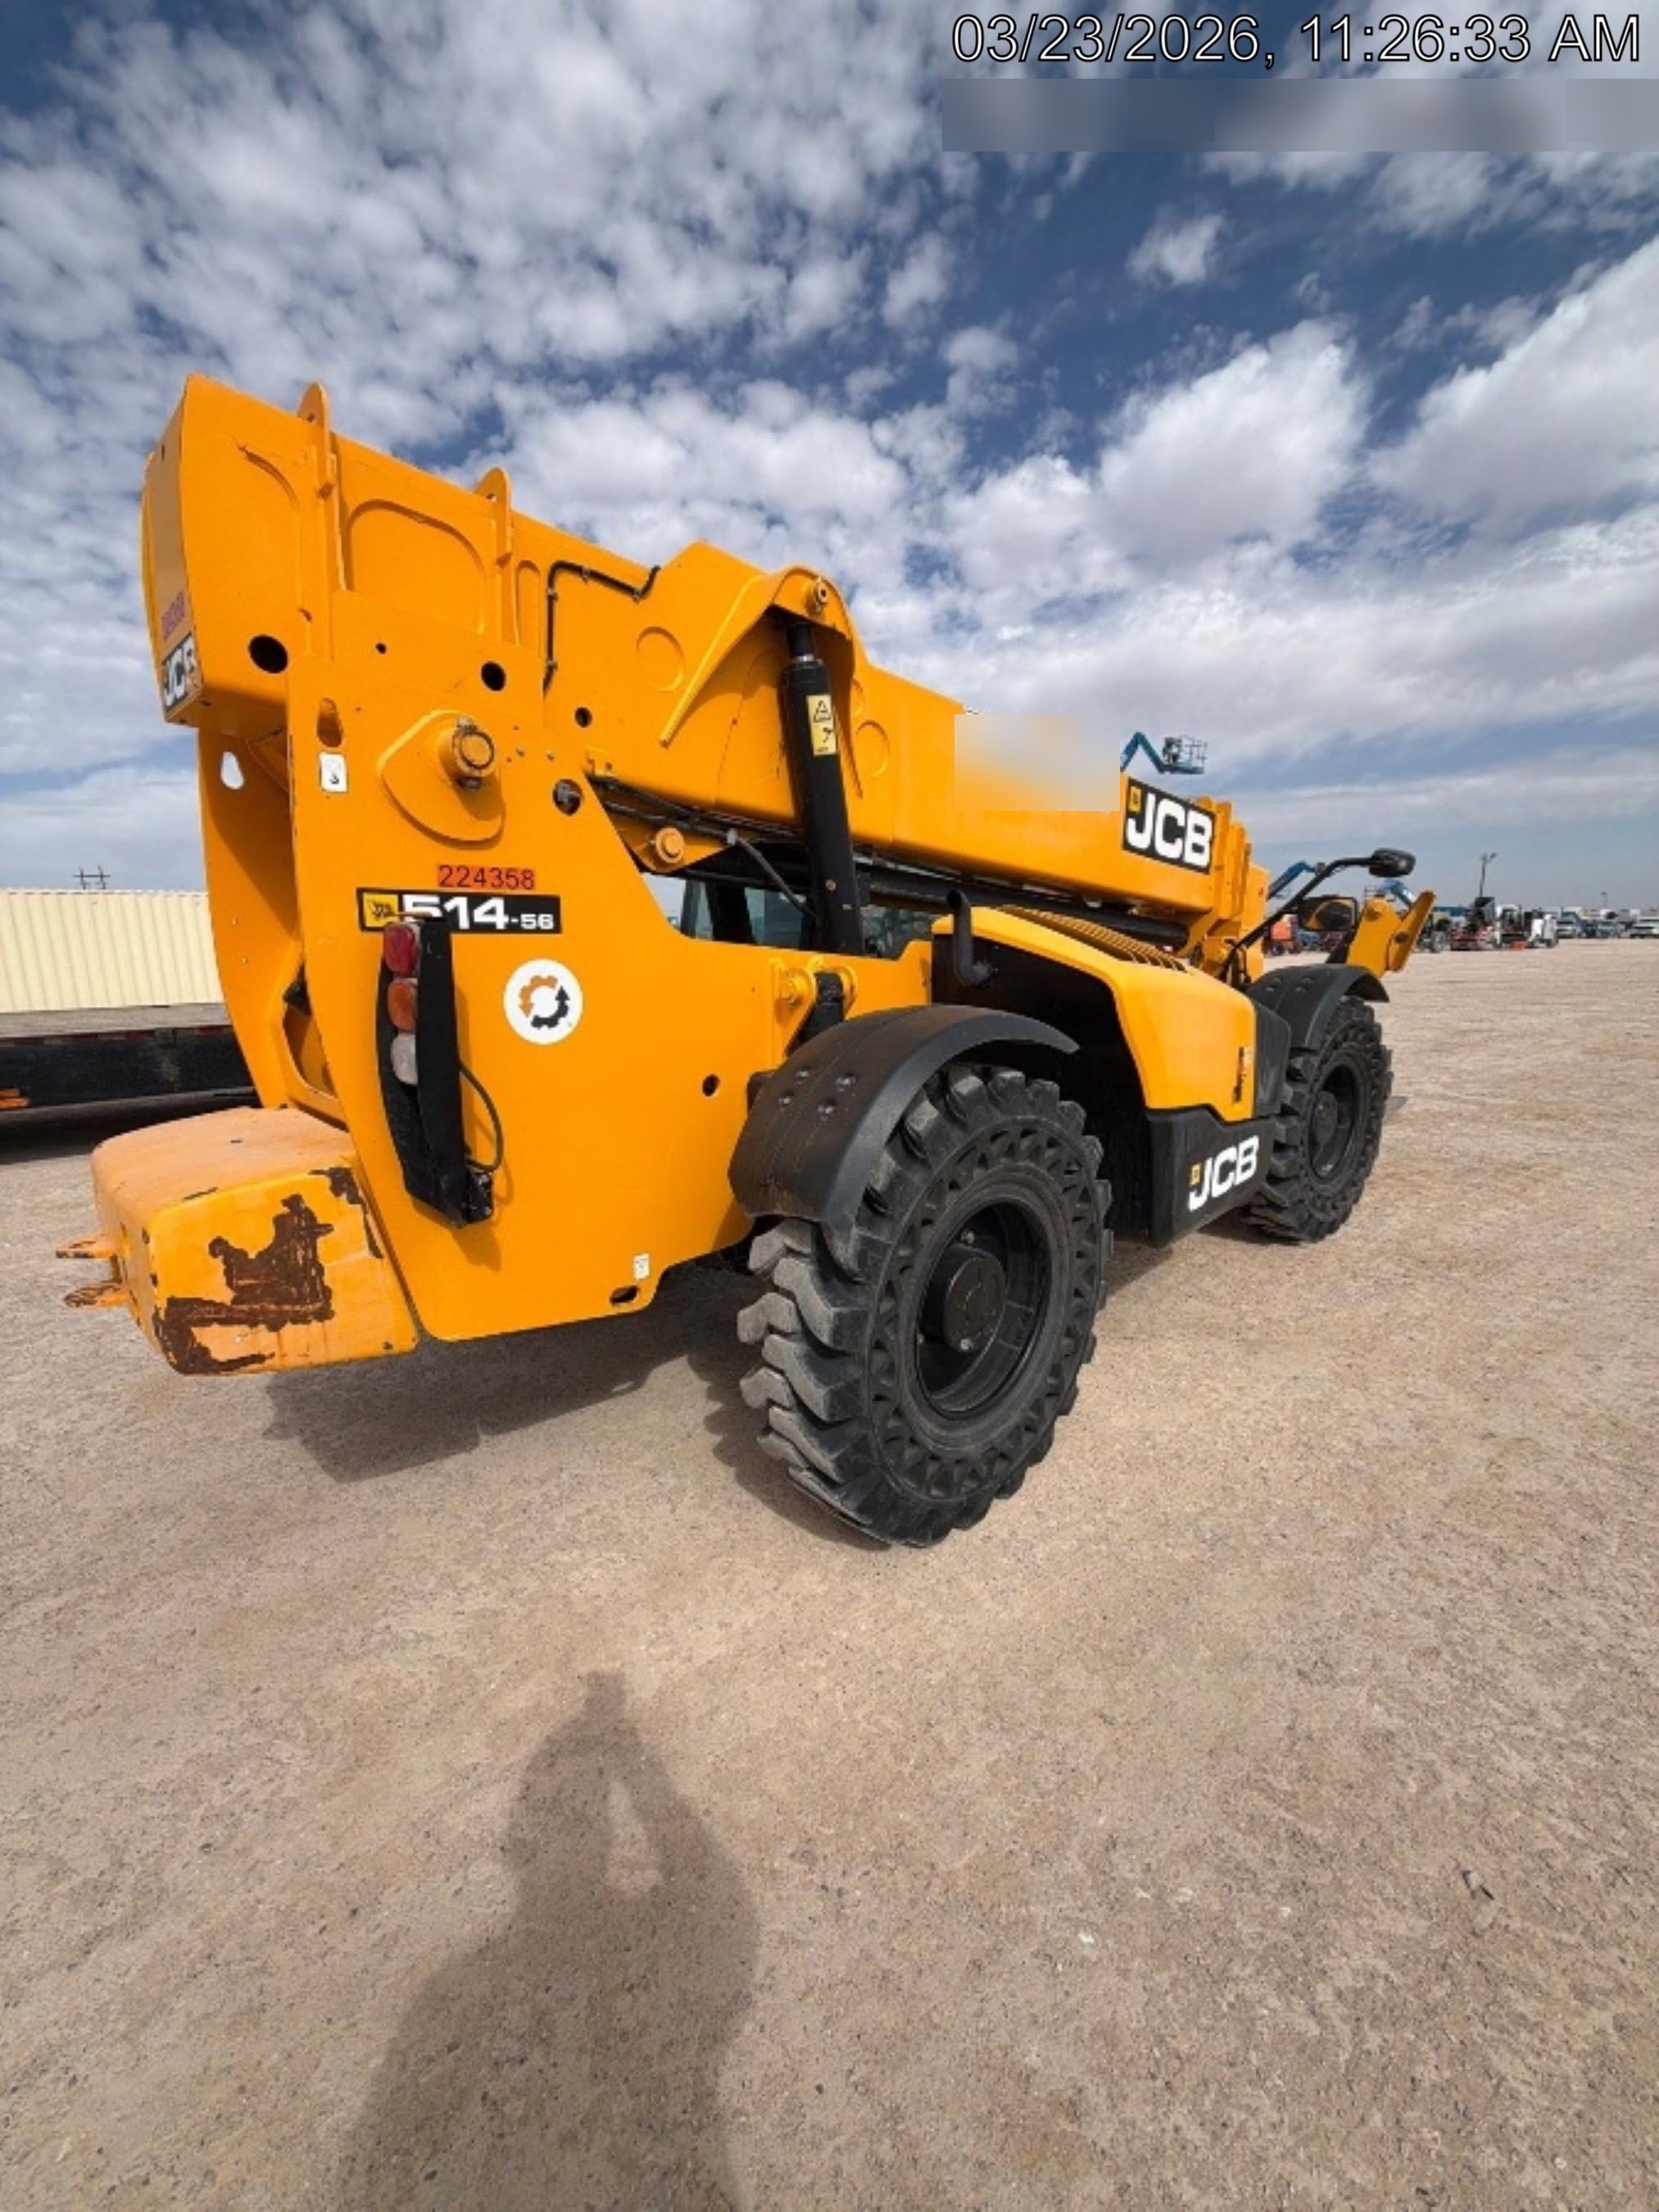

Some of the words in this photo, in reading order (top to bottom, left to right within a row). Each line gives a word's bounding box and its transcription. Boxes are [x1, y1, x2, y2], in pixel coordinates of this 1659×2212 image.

[1126, 792, 1213, 867] JCB
[438, 864, 534, 891] 224358
[1189, 1135, 1260, 1212] JCB
